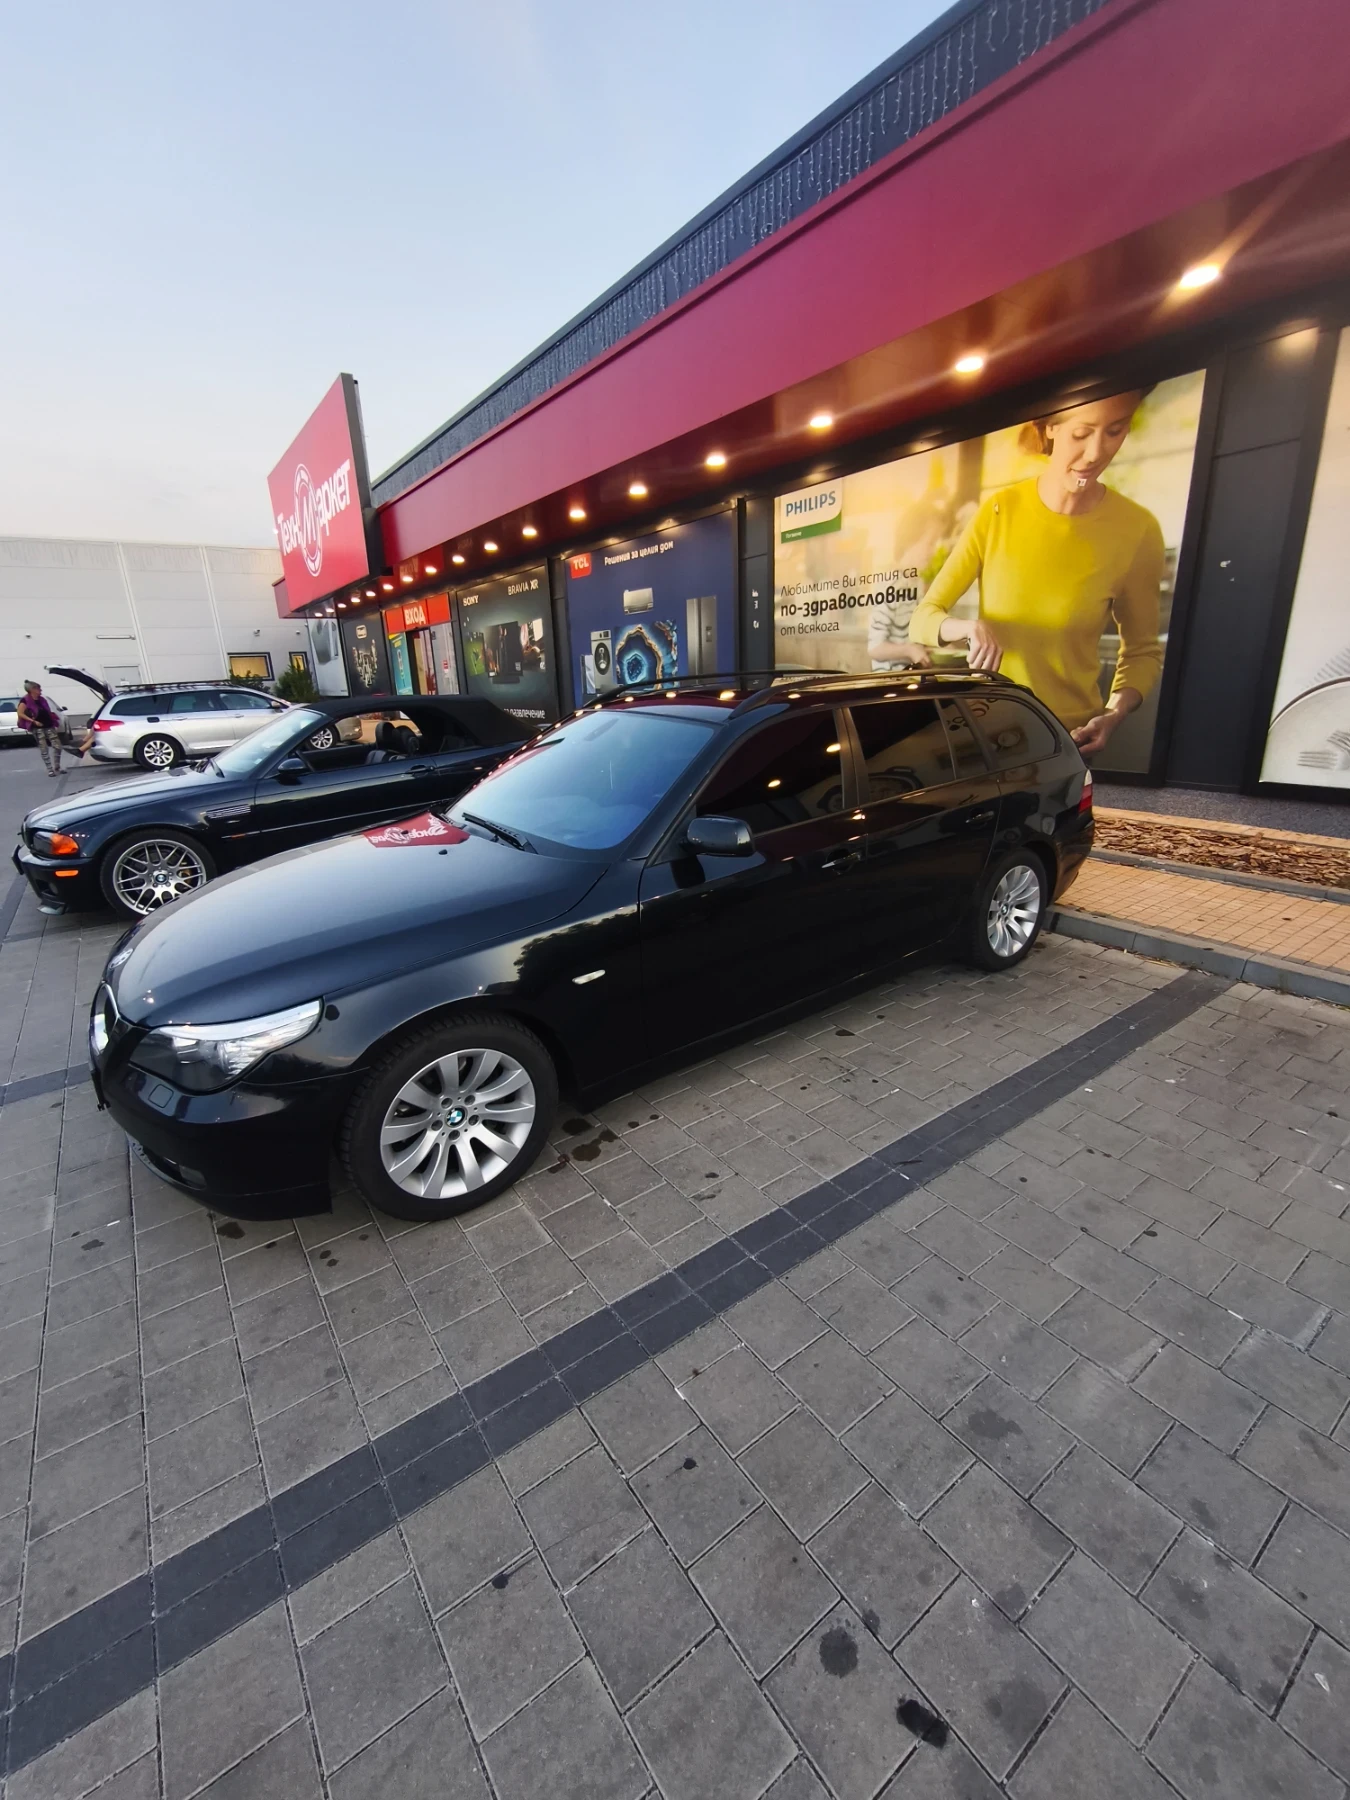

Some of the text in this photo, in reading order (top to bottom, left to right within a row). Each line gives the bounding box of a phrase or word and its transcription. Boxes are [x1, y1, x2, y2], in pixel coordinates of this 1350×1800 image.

[786, 490, 836, 517] PHILIPS
[573, 556, 590, 571] TCL
[604, 540, 674, 566] Решения за целия дом
[507, 578, 539, 596] BRAVIA XR
[780, 567, 918, 597] Любимите ви ястия са
[462, 595, 479, 607] SONY
[780, 585, 918, 617] по-здравословни
[403, 605, 427, 626] ВХОД
[780, 621, 840, 636] от всякога
